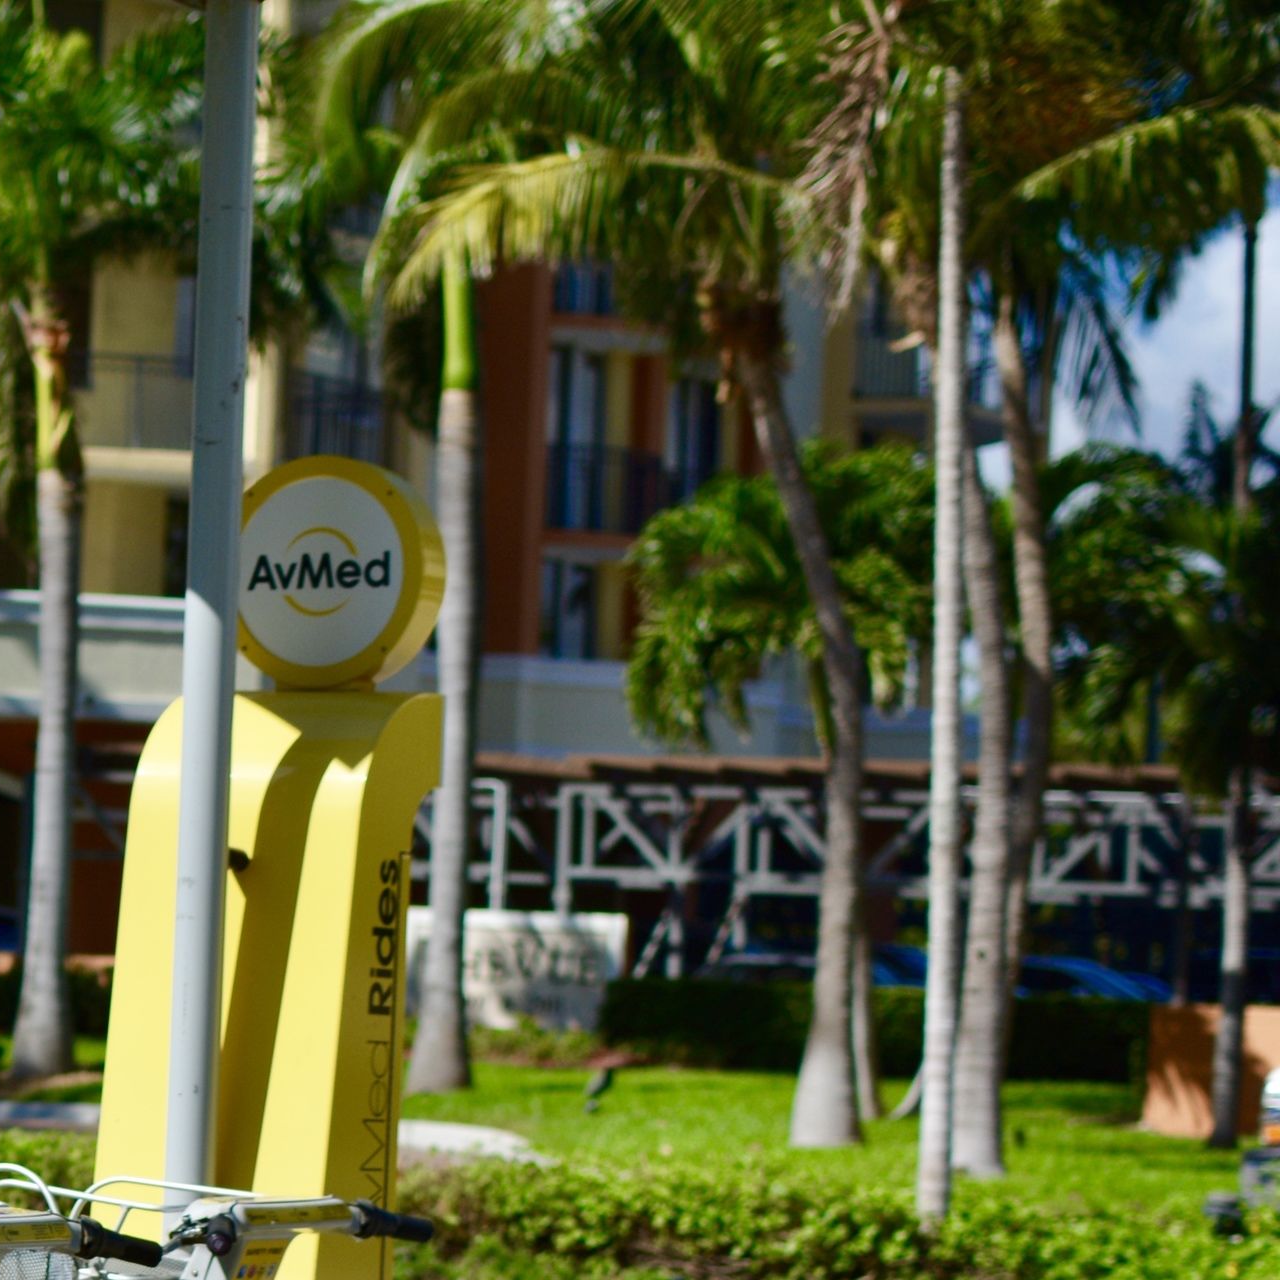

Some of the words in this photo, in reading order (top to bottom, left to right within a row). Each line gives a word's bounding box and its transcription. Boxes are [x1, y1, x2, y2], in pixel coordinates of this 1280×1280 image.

[246, 550, 392, 592] AvMed
[368, 858, 398, 1016] Rides
[359, 1039, 389, 1205] vMed
